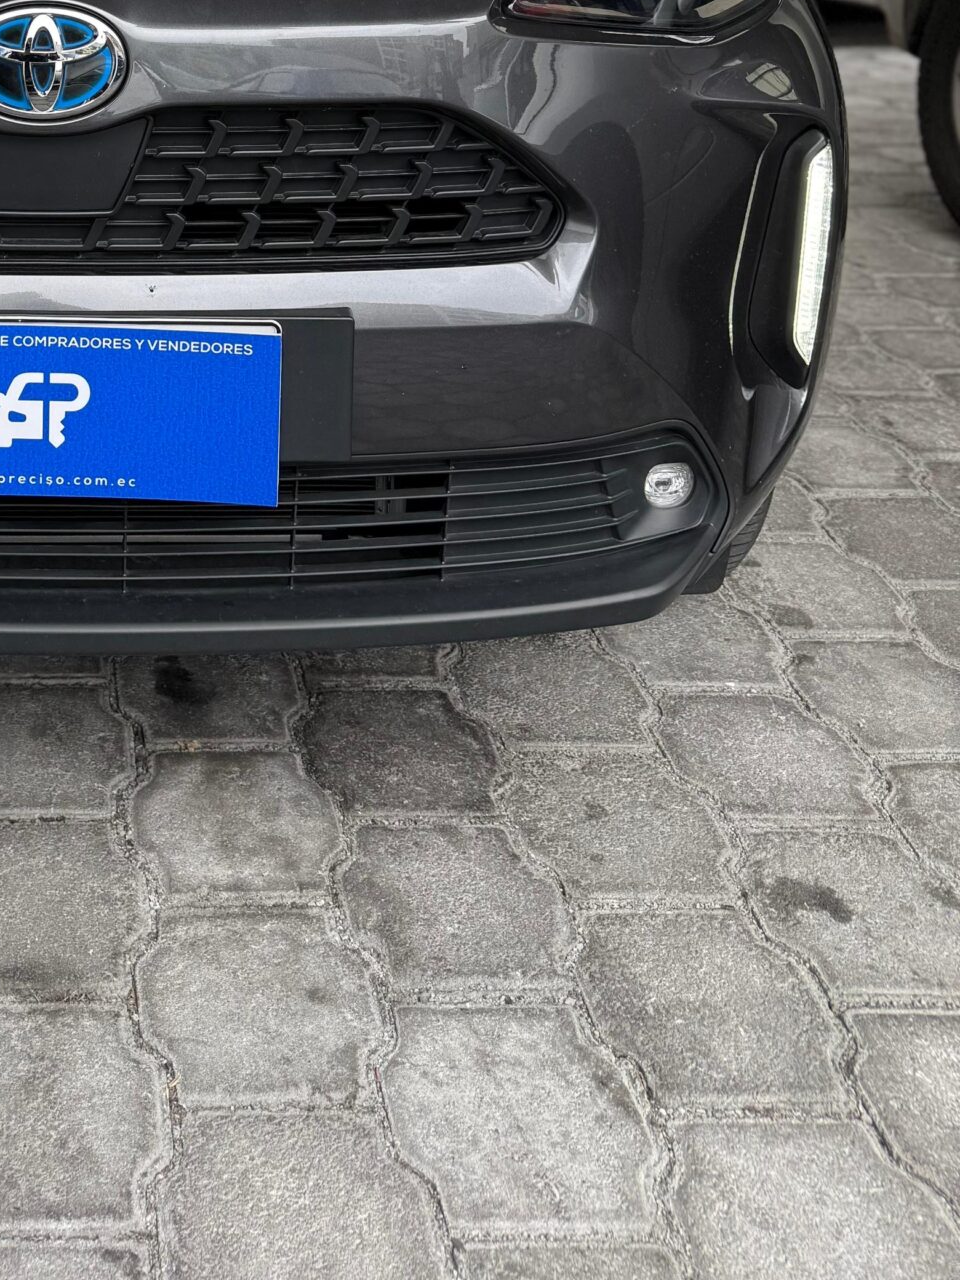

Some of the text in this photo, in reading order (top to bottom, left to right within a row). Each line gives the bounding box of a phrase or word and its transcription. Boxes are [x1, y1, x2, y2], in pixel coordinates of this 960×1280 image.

[13, 335, 132, 350] COMPRADORES
[135, 339, 145, 350] Y
[147, 339, 253, 356] VENDEDORES
